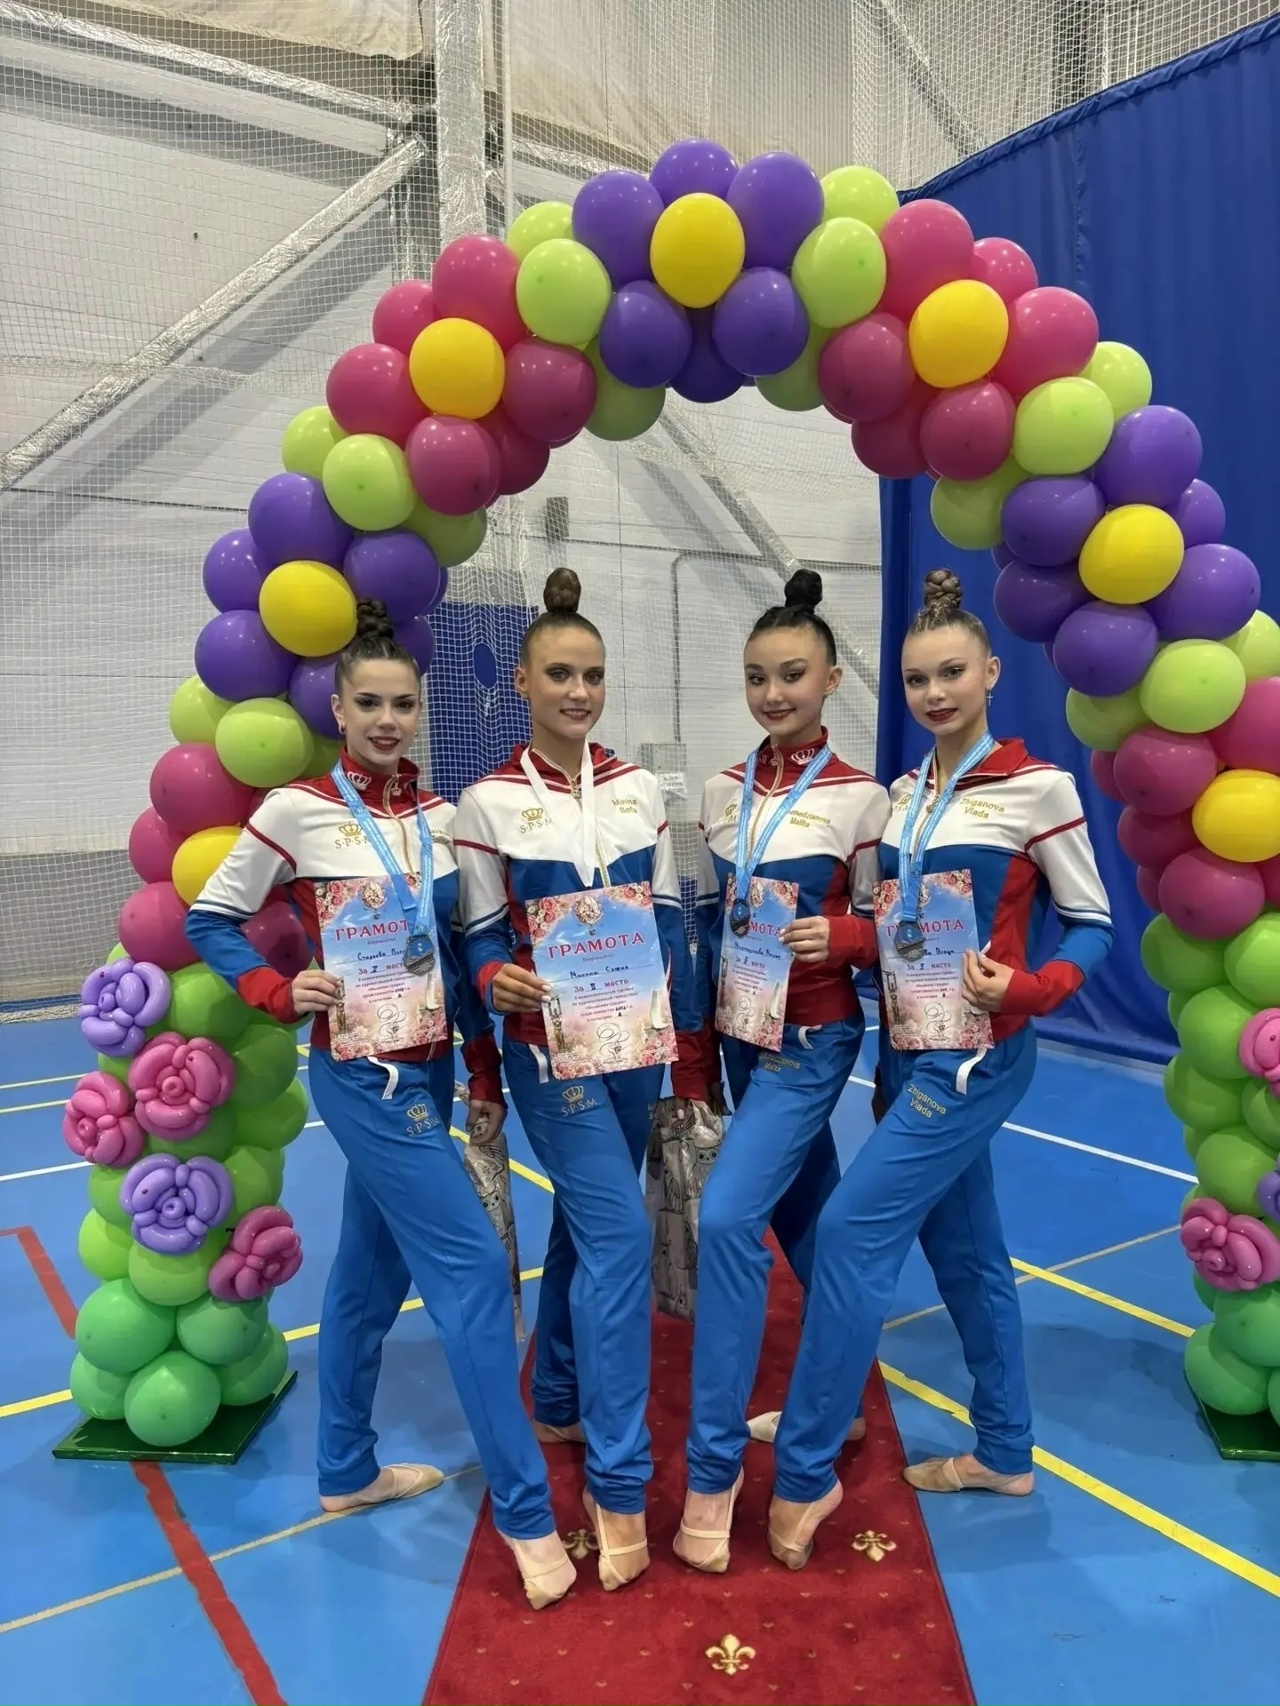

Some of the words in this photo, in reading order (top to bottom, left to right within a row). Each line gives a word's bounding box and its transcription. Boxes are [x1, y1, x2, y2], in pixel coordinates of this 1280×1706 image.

[960, 797, 1005, 813] Zhiganova
[964, 806, 989, 819] Vlada
[335, 920, 409, 941] ГРАМОТ
[749, 920, 781, 936] МОТА
[887, 919, 964, 937] ГМОТА
[548, 932, 645, 959] ГРАМОТА
[386, 962, 404, 970] мест
[604, 979, 629, 988] место
[908, 1084, 947, 1114] Zhiganova
[910, 1098, 932, 1118] Vlada
